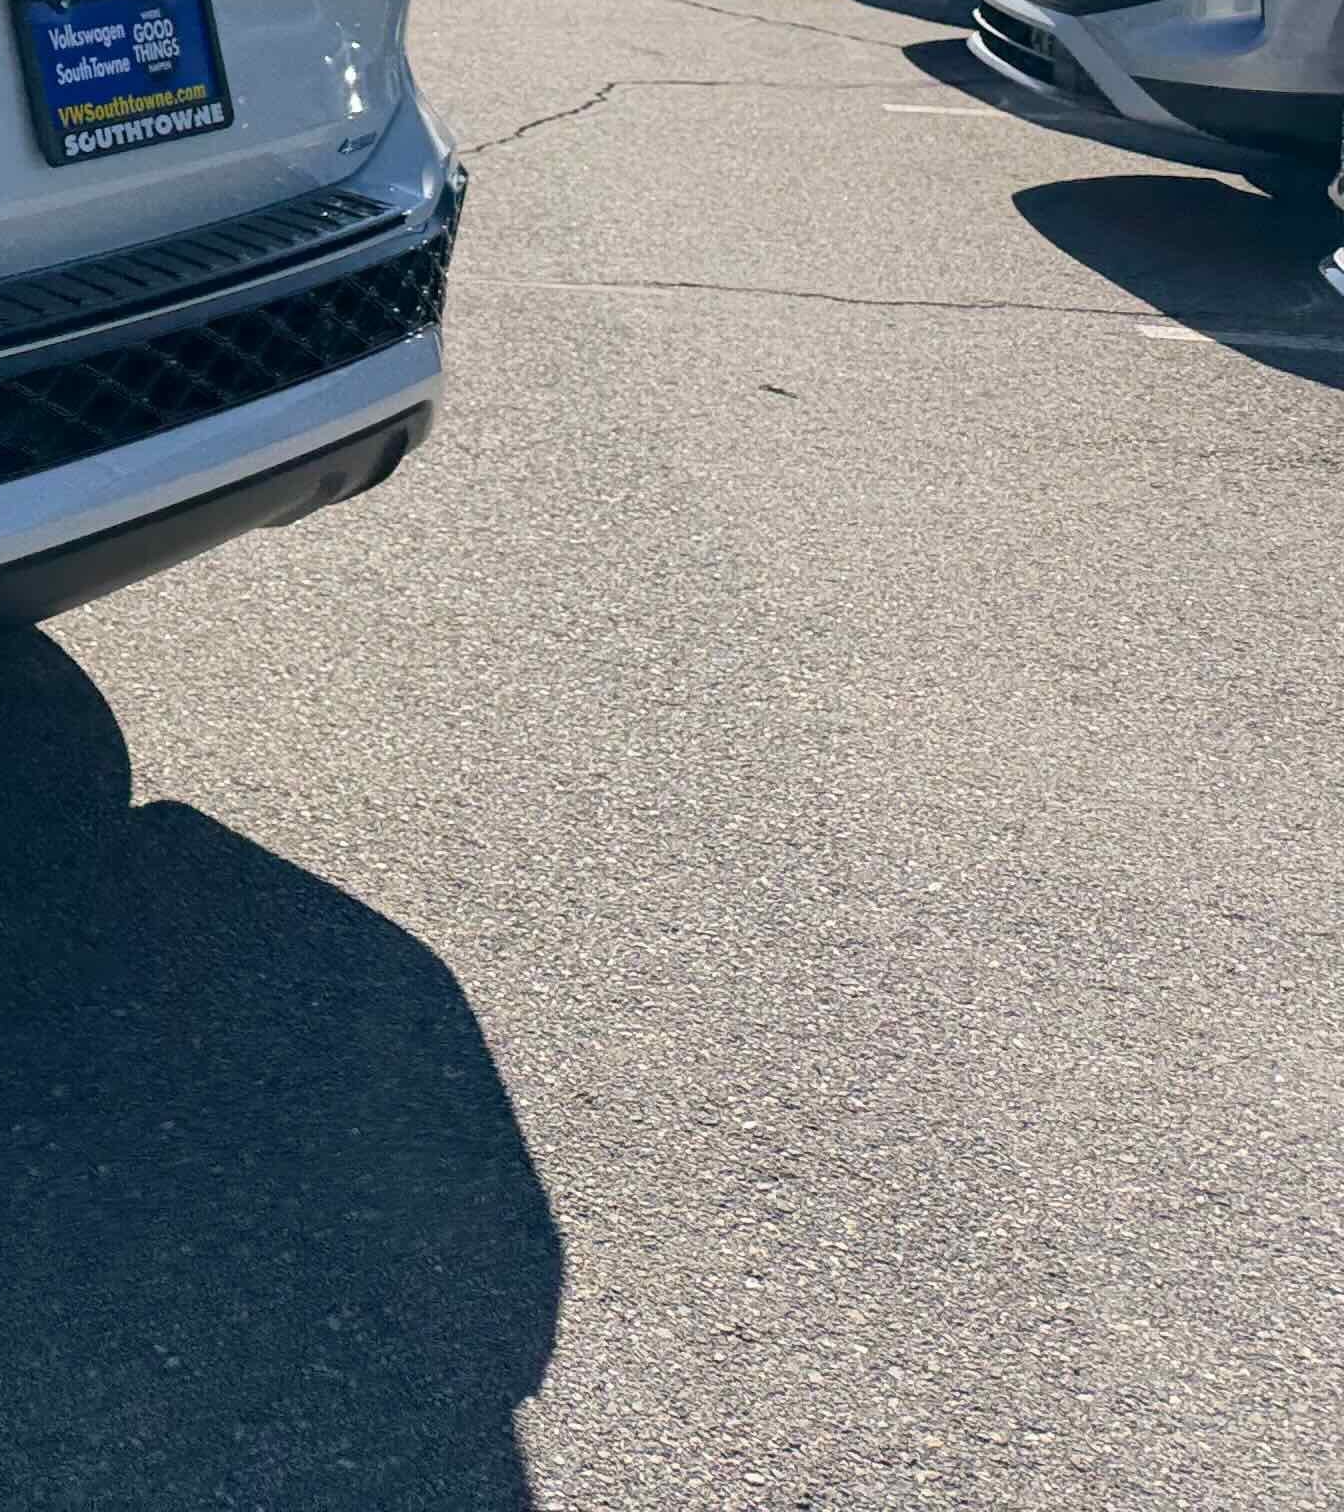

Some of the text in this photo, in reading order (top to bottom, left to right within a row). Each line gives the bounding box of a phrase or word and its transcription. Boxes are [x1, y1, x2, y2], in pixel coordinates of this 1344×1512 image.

[48, 24, 126, 51] Volkswagen
[133, 18, 174, 43] GOOD
[132, 37, 180, 64] THINGS
[58, 83, 207, 128] VWSouthtowne.com
[65, 102, 225, 156] SOUTHTOWNE
